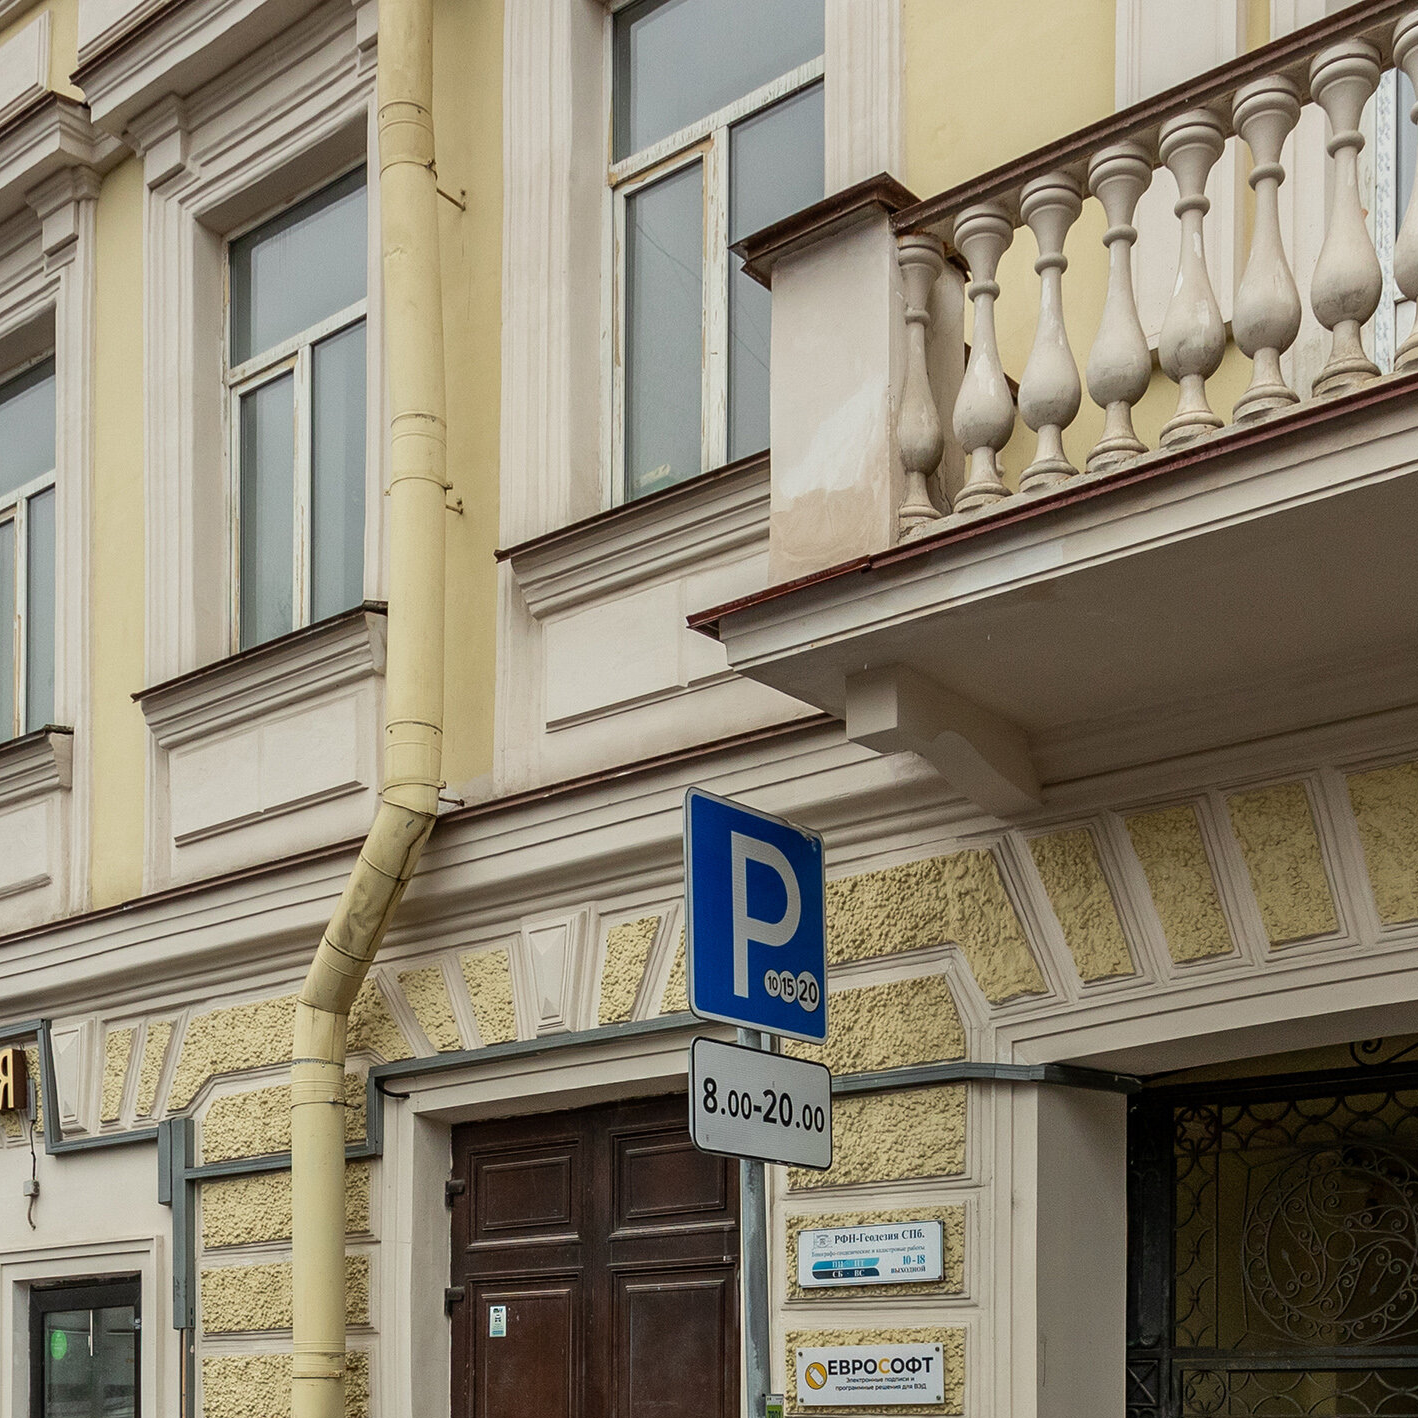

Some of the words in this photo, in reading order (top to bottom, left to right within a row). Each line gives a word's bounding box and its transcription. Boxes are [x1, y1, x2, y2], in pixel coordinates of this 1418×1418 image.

[731, 831, 802, 998] P
[767, 974, 778, 992] 10
[781, 977, 795, 997] 15
[798, 979, 817, 1004] 20
[703, 1076, 825, 1133] 8.00-20.00
[834, 1232, 899, 1244] РФН-Геодезия
[901, 1229, 925, 1239] СПб.
[854, 1269, 865, 1277] ВС
[828, 1356, 934, 1376] ЕВРОСОФТ
